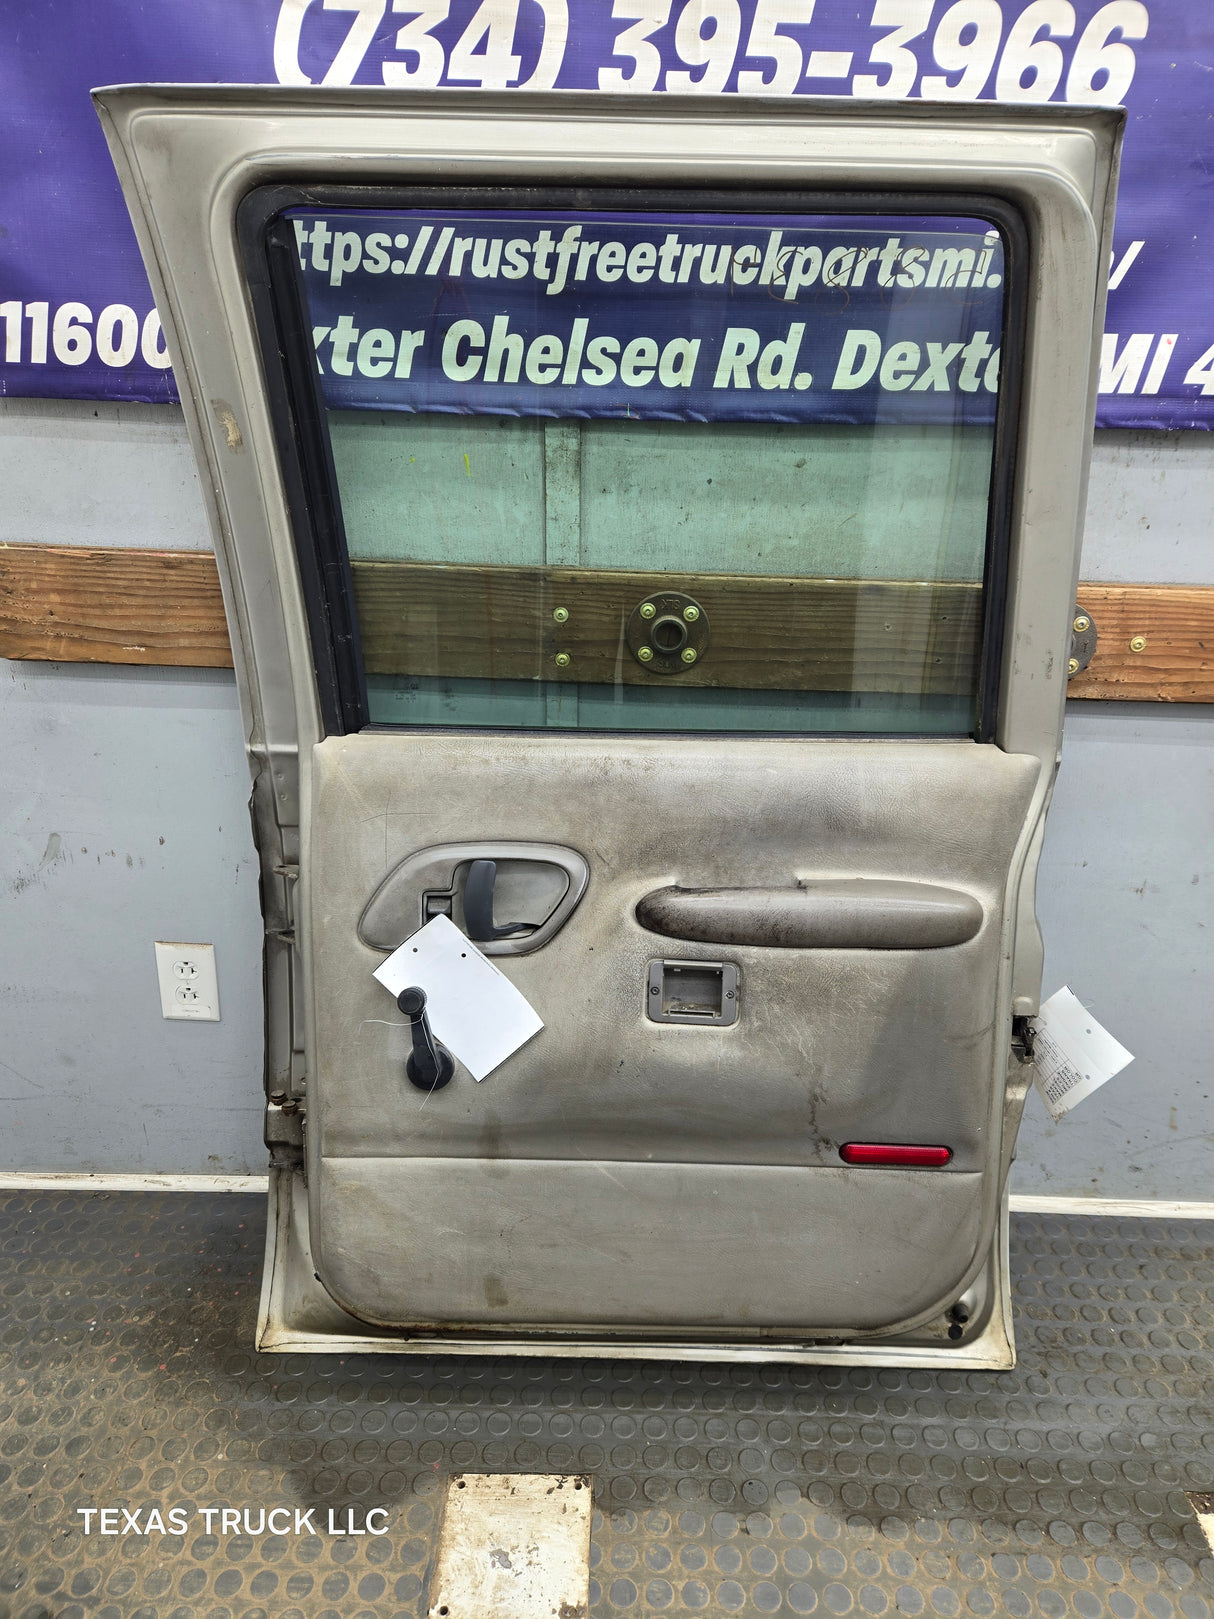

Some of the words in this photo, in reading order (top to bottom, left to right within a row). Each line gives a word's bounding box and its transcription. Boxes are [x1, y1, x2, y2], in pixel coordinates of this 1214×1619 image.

[273, 0, 569, 90] (734)
[598, 0, 1149, 106] 395-3966
[441, 315, 702, 389] Chelsea
[712, 322, 813, 391] Rd.
[1098, 333, 1179, 395] MI
